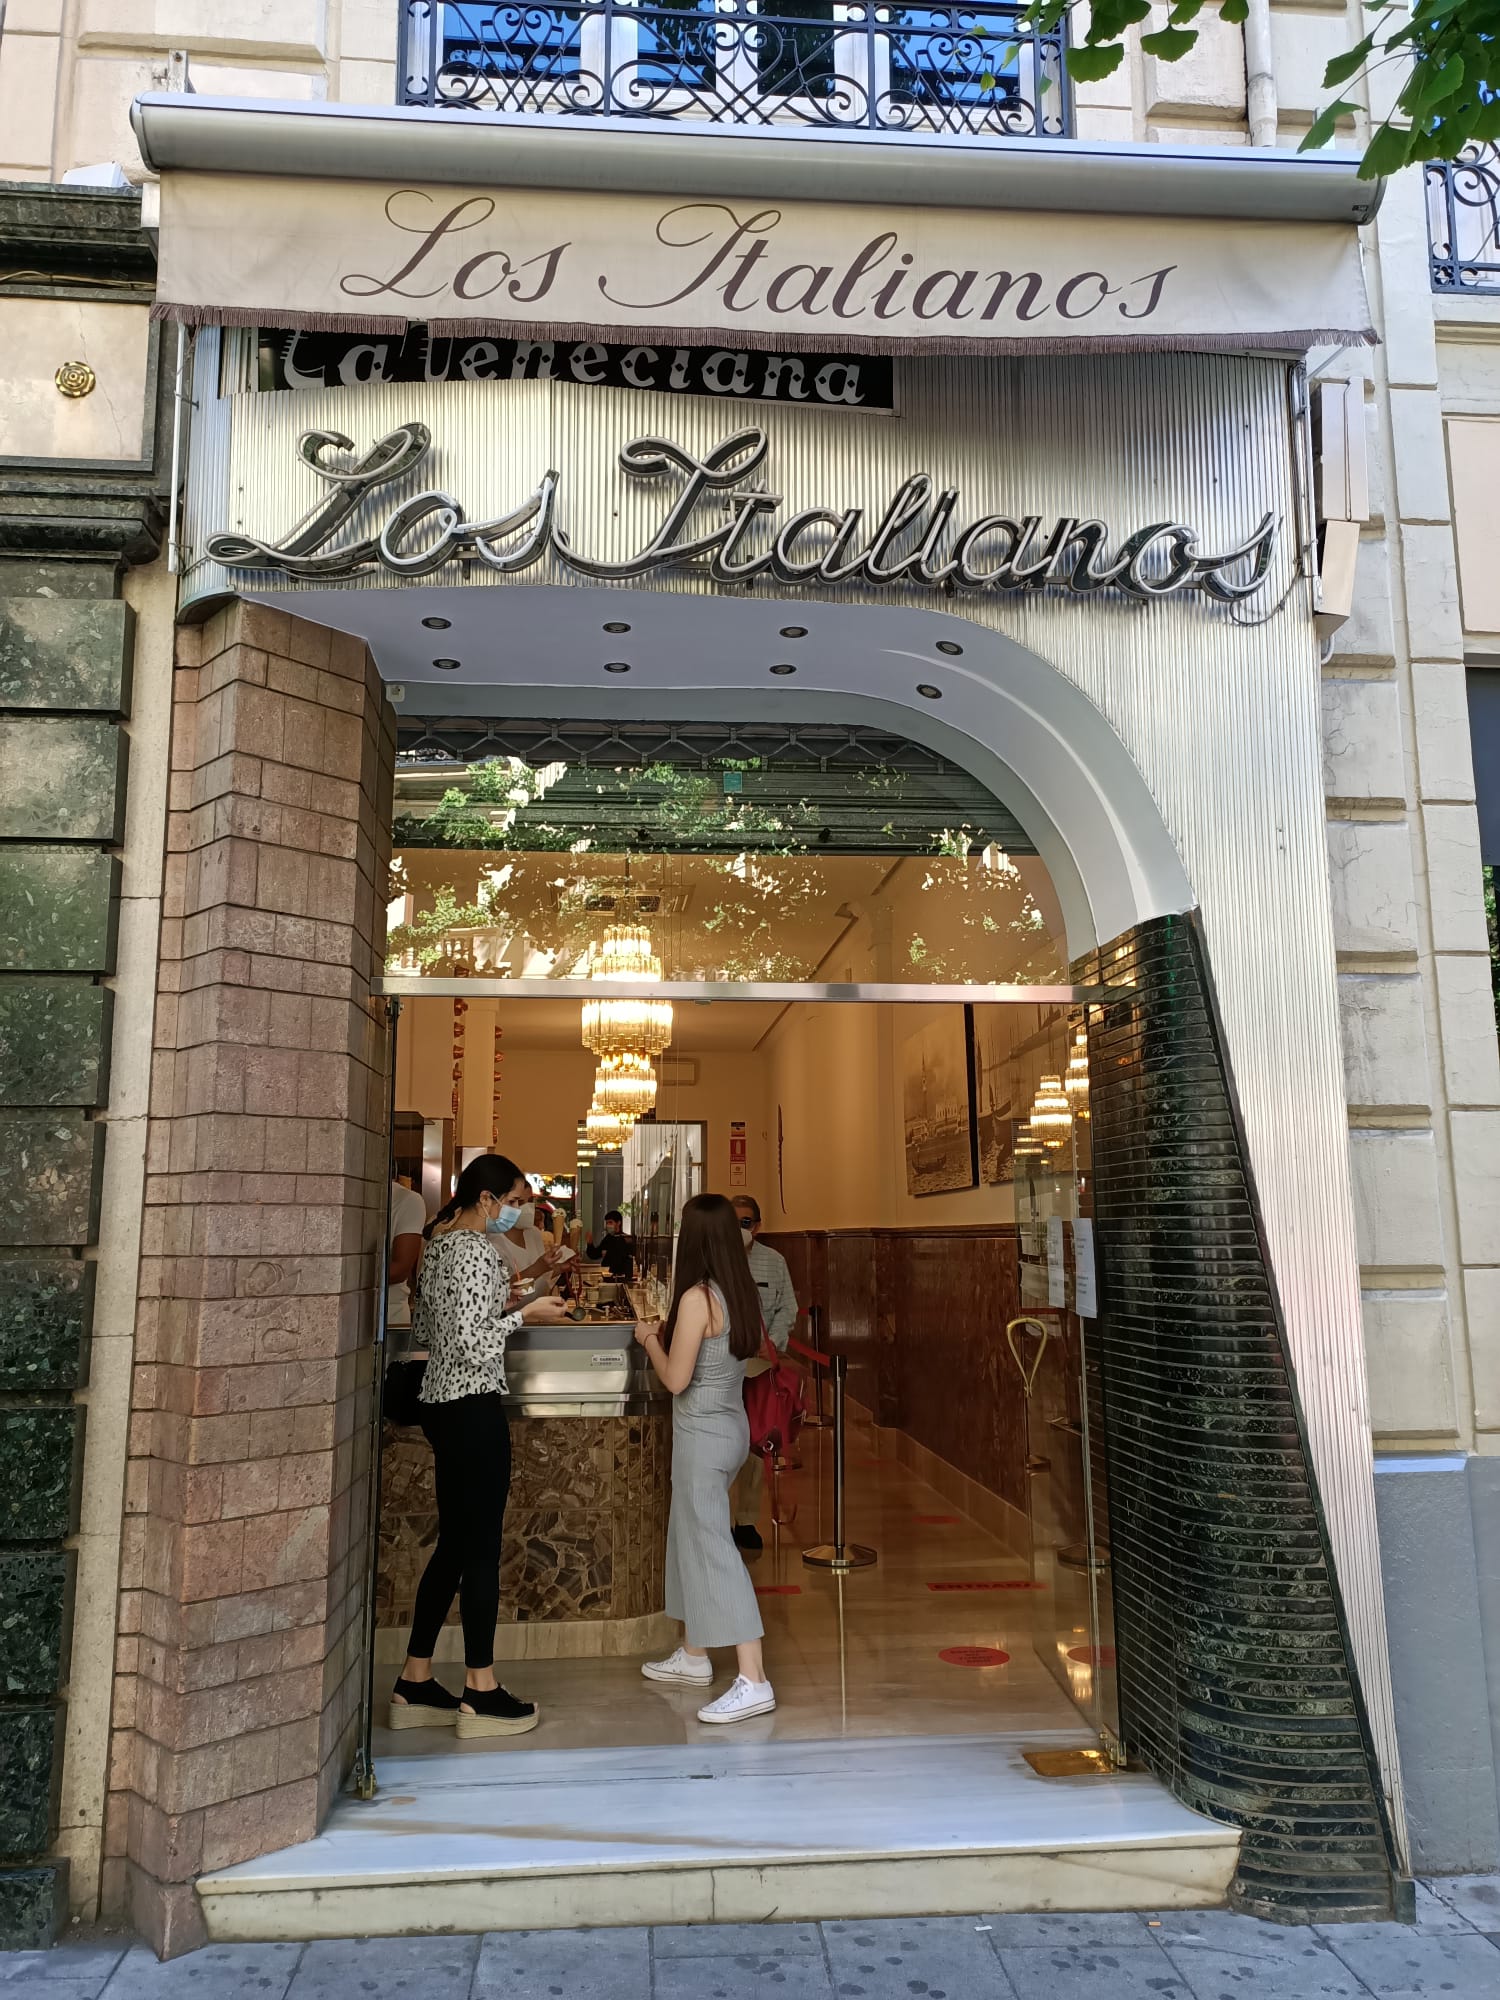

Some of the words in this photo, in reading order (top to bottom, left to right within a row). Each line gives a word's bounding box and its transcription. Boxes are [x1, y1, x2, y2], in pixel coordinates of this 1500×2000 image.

[339, 188, 572, 303] Los
[598, 202, 1177, 321] Italianos
[203, 421, 560, 582] Los
[551, 425, 1283, 602] Italianos
